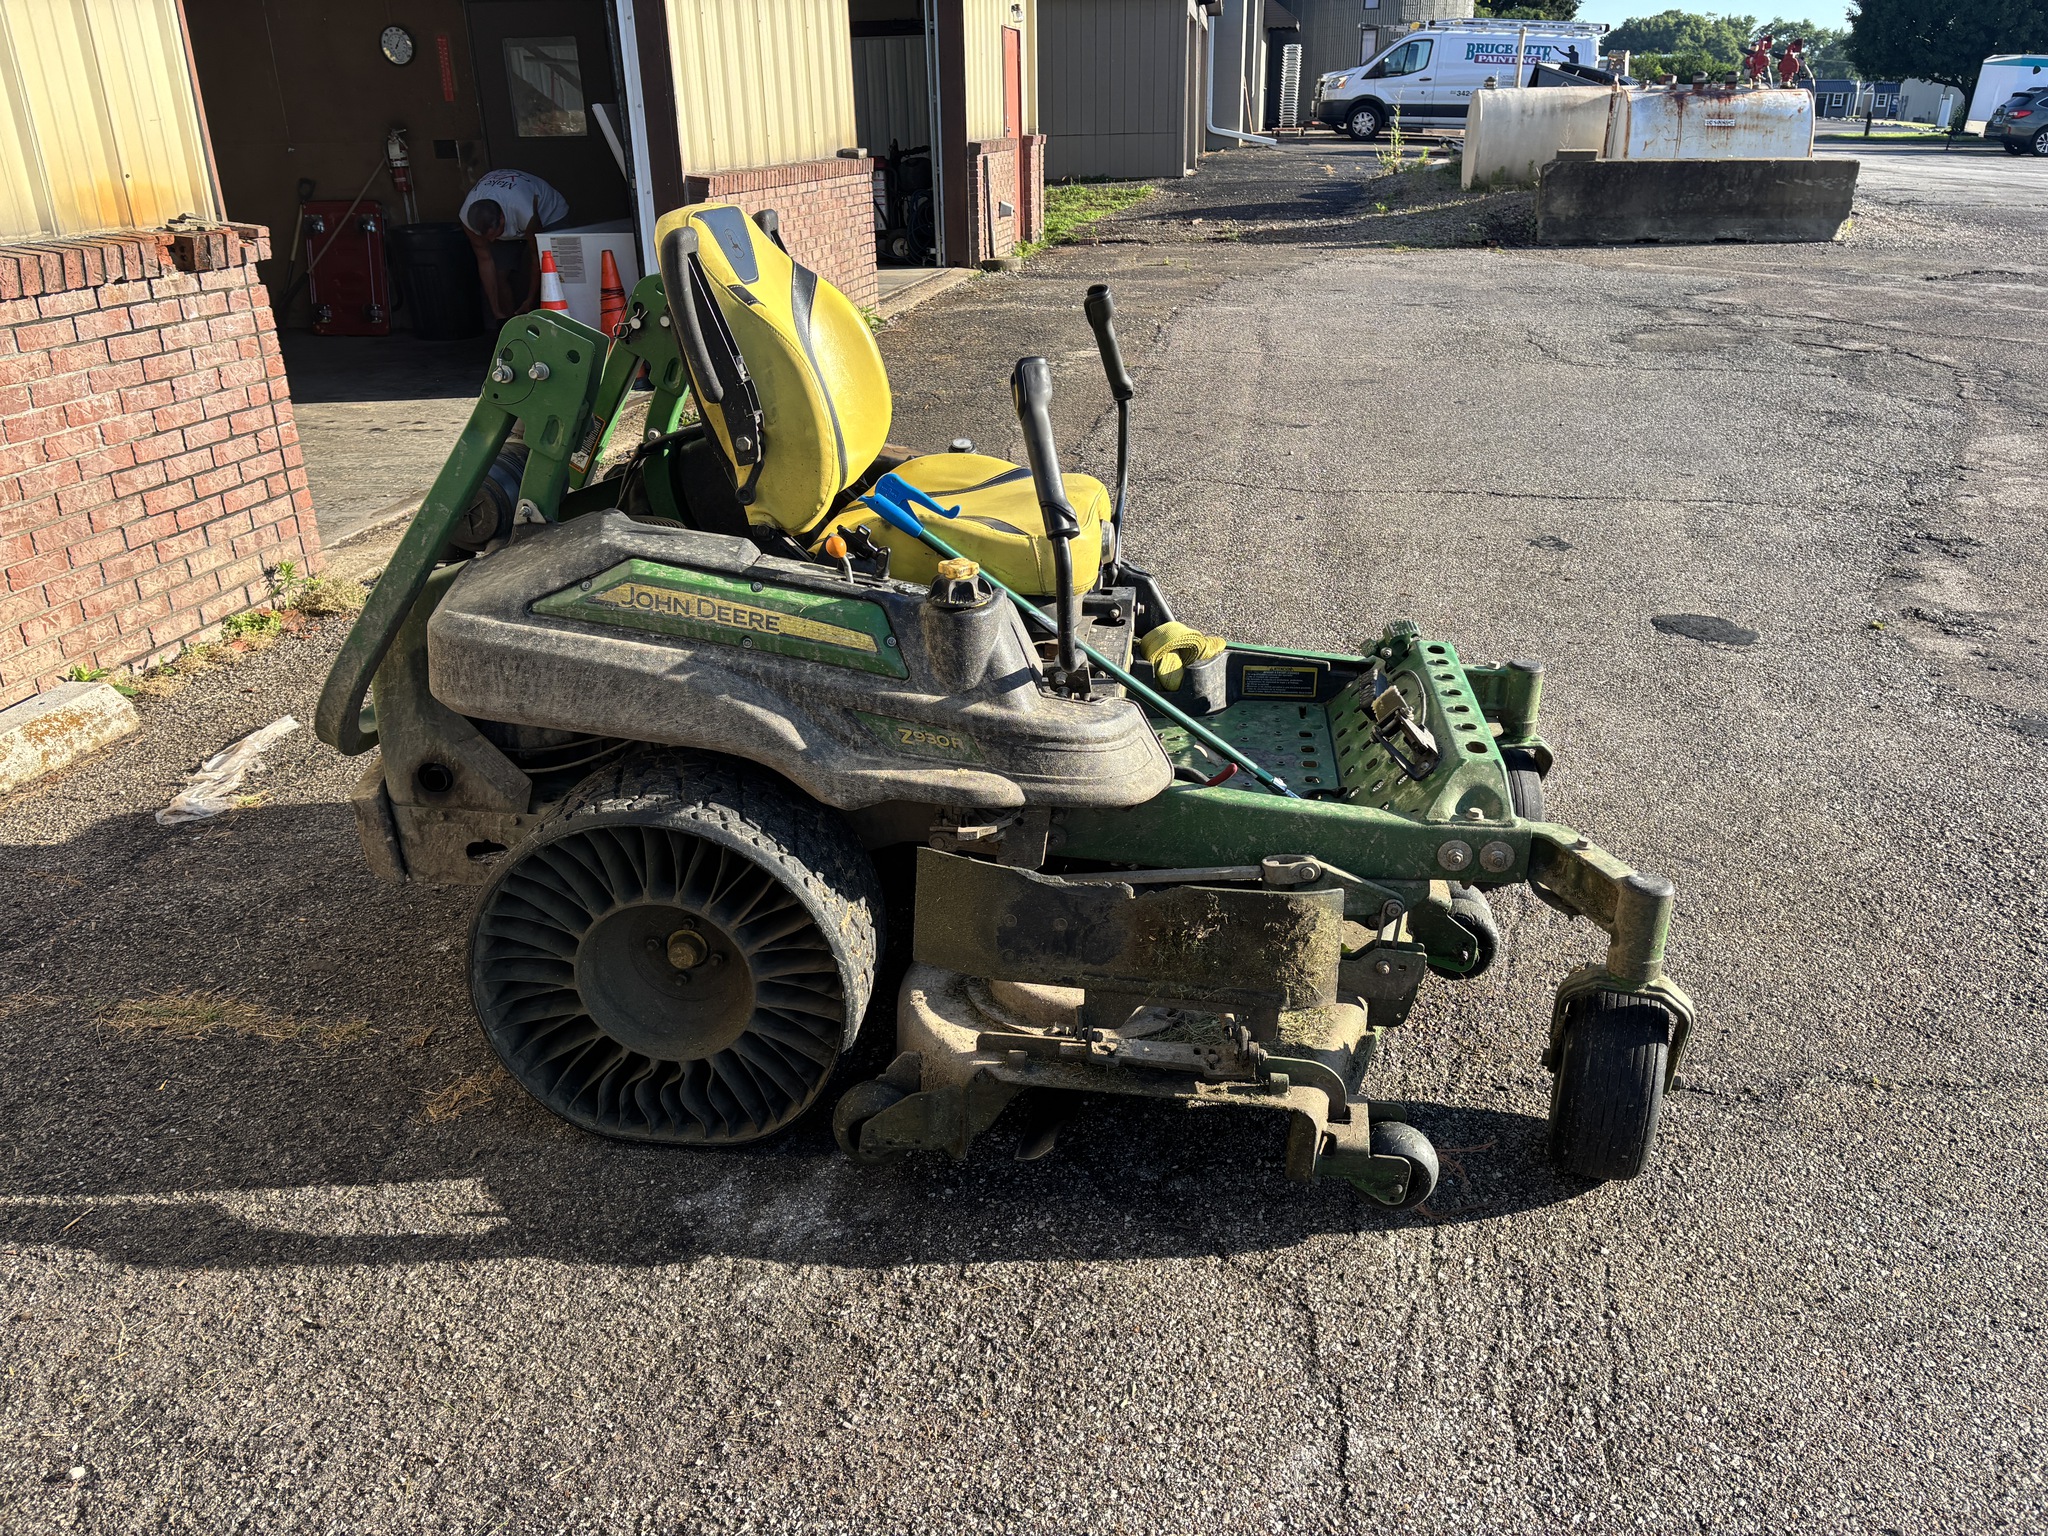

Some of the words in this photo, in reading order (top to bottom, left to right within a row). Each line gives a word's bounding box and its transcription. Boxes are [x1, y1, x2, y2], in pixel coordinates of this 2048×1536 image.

[1465, 43, 1513, 60] BRUCE
[621, 587, 690, 615] JOHN
[697, 598, 780, 632] DEERE
